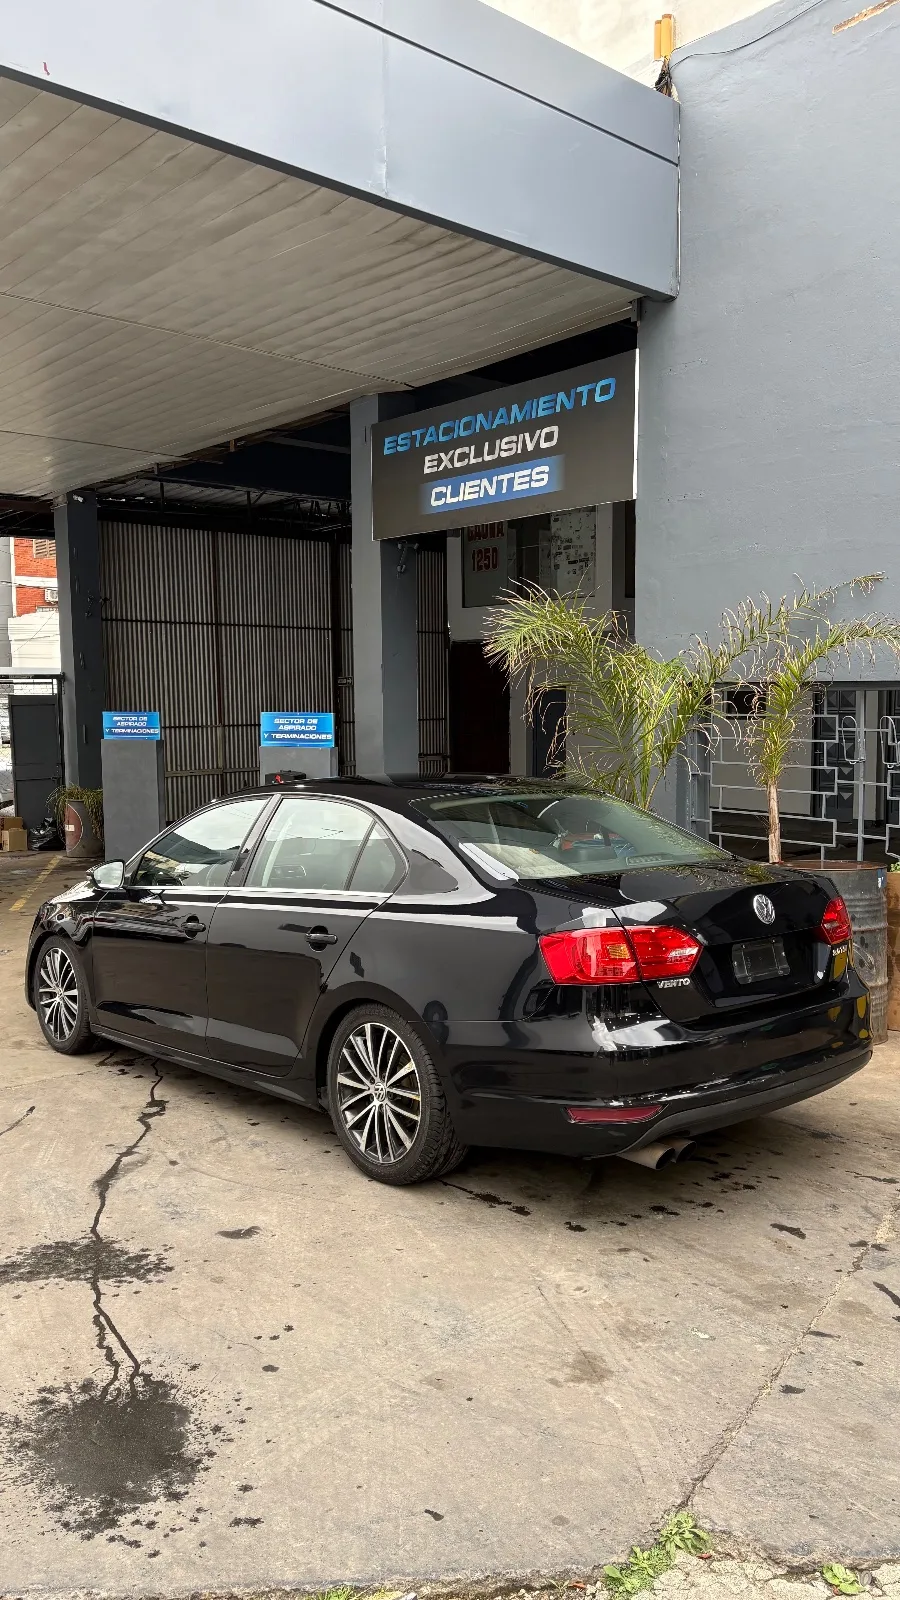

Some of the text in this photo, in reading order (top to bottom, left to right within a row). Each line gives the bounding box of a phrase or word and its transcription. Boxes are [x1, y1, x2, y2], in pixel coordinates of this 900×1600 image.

[383, 377, 616, 455] ESTACIONAMIENTO
[423, 425, 559, 474] EXCLUSIVO
[430, 465, 549, 507] CLIENTES
[472, 546, 499, 572] 1250
[656, 977, 691, 989] VENTO
